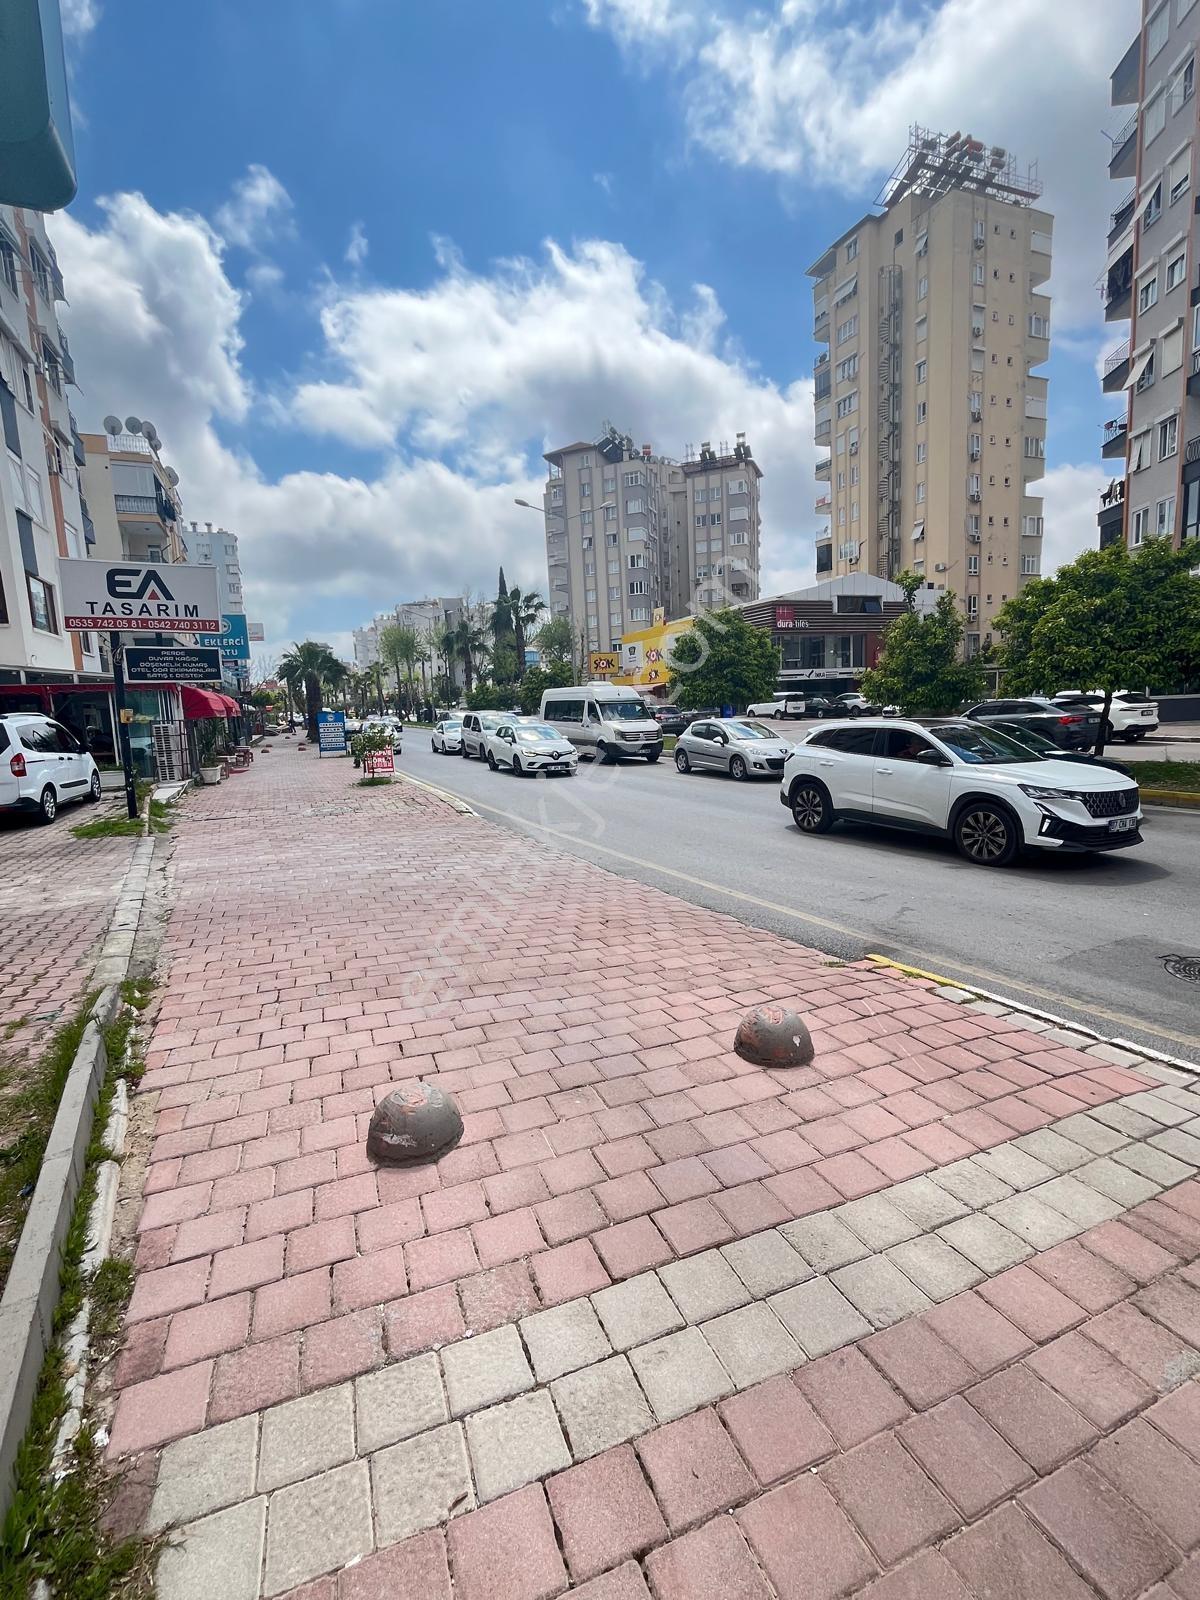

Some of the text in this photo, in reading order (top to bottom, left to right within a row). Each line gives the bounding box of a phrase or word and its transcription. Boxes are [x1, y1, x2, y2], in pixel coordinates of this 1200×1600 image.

[106, 568, 175, 600] EA
[86, 602, 199, 617] TASARIM
[69, 618, 94, 627] 0535
[96, 619, 114, 628] 742
[117, 620, 128, 628] 05
[173, 621, 190, 630] 740
[204, 636, 245, 646] EKLERCİ
